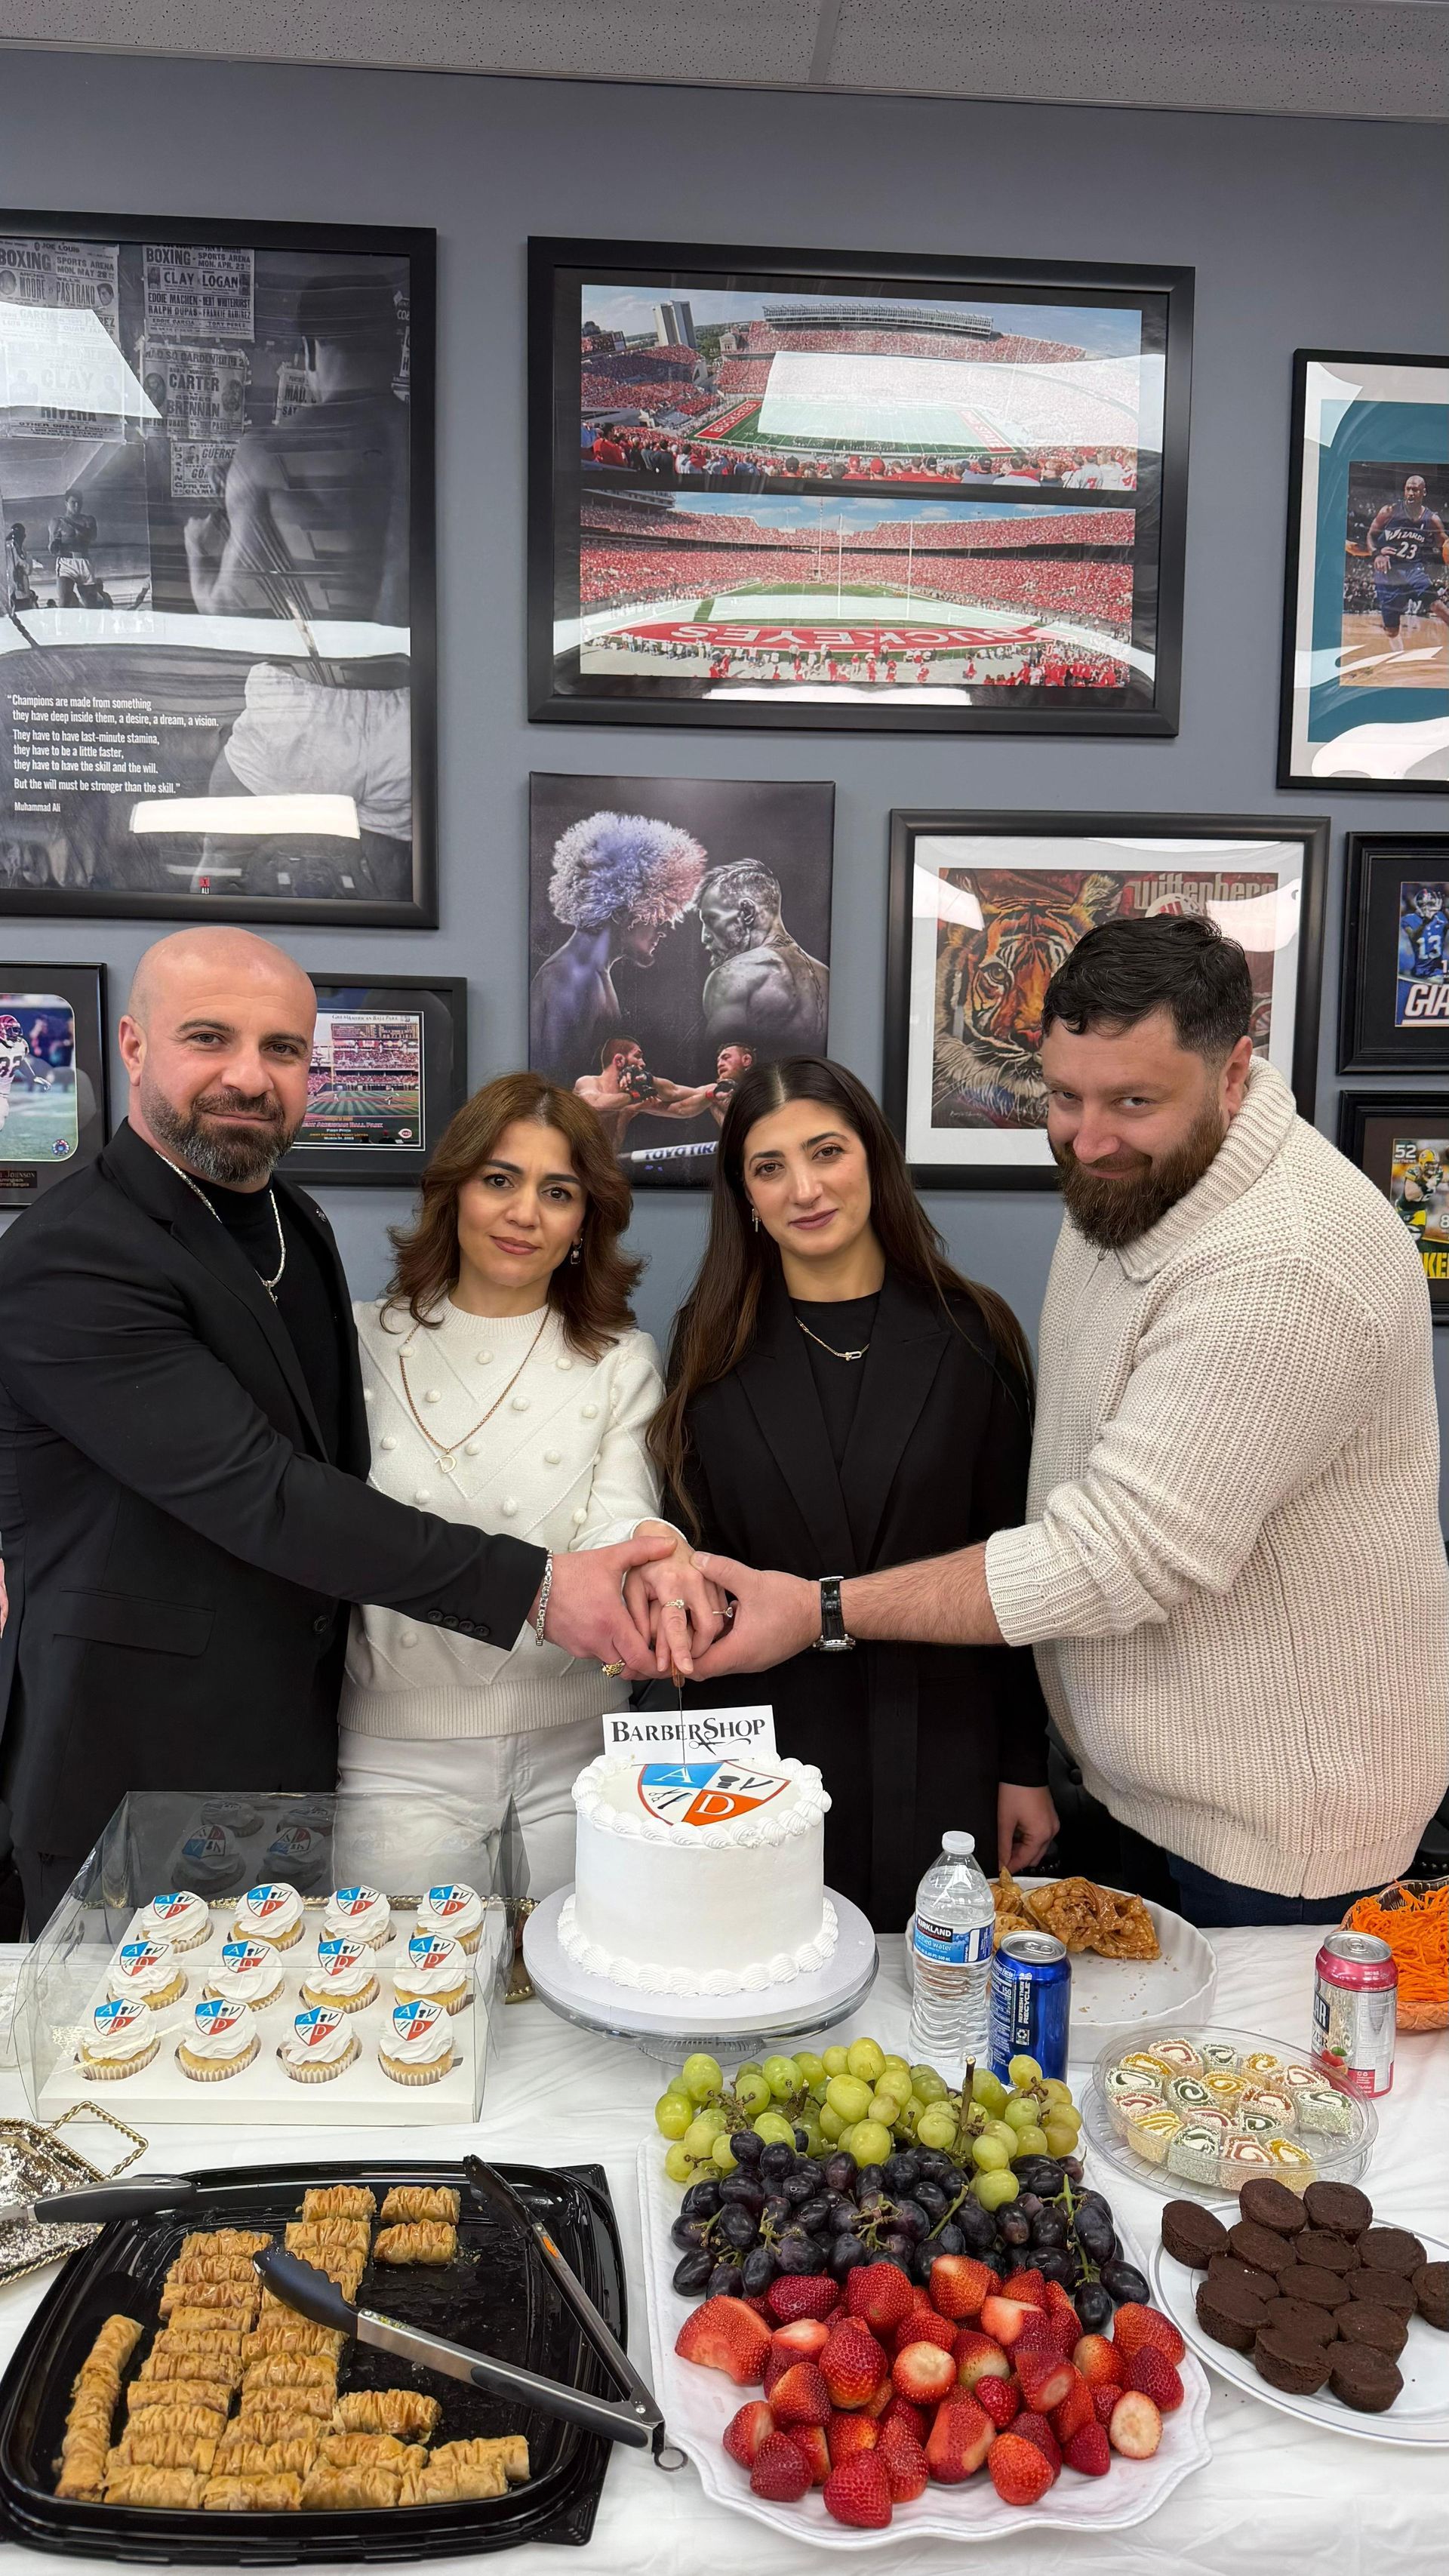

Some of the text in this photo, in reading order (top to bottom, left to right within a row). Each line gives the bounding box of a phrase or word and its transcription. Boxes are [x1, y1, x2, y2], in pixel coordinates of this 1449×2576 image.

[58, 244, 79, 253] LOUIS
[0, 248, 52, 271] BOXING
[146, 248, 190, 266] BOXING
[198, 252, 251, 263] SPORTS ARENA
[57, 256, 114, 271] SPORTS ARENA
[198, 260, 216, 268] MON.
[57, 265, 75, 275] MON.
[78, 267, 94, 277] MAY
[164, 271, 195, 285] CLAY
[202, 274, 238, 288] LOGAN
[20, 276, 46, 300] MOORE
[57, 282, 95, 305] PASTRANO
[148, 293, 198, 306] EDDIE MACHEN
[148, 306, 198, 317] RALPH DUPAS
[203, 309, 225, 319] FRANKIE
[180, 353, 216, 365] GARDEN
[169, 374, 220, 392] CARTER
[167, 400, 220, 417] BRENNAN
[1396, 541, 1418, 559] 23
[669, 625, 1029, 647] BUCKEYES
[56, 698, 68, 706] are
[70, 697, 91, 707] made
[93, 697, 110, 708] from
[112, 698, 152, 711] something
[12, 709, 29, 722] they
[31, 710, 49, 722] have
[51, 711, 69, 724] deep
[71, 711, 93, 722] inside
[95, 712, 117, 725] them,
[125, 713, 151, 725] desire,
[160, 714, 186, 728] dream,
[195, 715, 219, 726] vision.
[13, 729, 159, 745] They have to have last-minute stamina,
[14, 744, 30, 757] they
[32, 744, 50, 756] have
[51, 746, 60, 756] to
[61, 745, 70, 756] be
[79, 746, 97, 757] little
[99, 746, 124, 759] faster,
[14, 759, 158, 774] they have to have the skill and the will.
[14, 778, 28, 789] But
[29, 778, 42, 789] the
[44, 779, 57, 789] will
[58, 780, 78, 790] must
[80, 780, 89, 791] be
[91, 781, 122, 793] stronger
[125, 782, 142, 792] than
[143, 782, 156, 792] the
[14, 802, 61, 812] Muhammad Ali
[1416, 934, 1442, 960] 13
[1395, 1143, 1417, 1159] 52
[654, 1765, 695, 1784] A
[694, 1794, 736, 1816] D
[159, 1894, 171, 1903] A
[254, 1890, 264, 1898] A
[341, 1890, 352, 1899] A
[434, 1889, 445, 1897] A
[171, 1904, 182, 1913] D
[264, 1901, 276, 1911] D
[355, 1901, 366, 1911] D
[446, 1902, 457, 1912] D
[918, 1917, 952, 1937] KIRKLAND
[127, 1946, 139, 1955] A
[227, 1946, 240, 1955] A
[325, 1943, 336, 1952] A
[414, 1941, 426, 1950] A
[933, 1941, 952, 1951] water
[337, 1957, 349, 1968] D
[427, 1954, 439, 1965] D
[1002, 1986, 1011, 1996] 150
[100, 2005, 113, 2015] A
[201, 2005, 214, 2014] A
[398, 2008, 411, 2017] A
[113, 2017, 126, 2028] D
[214, 2019, 227, 2029] D
[300, 2014, 312, 2023] A
[314, 2025, 327, 2036] D
[412, 2021, 425, 2032] D
